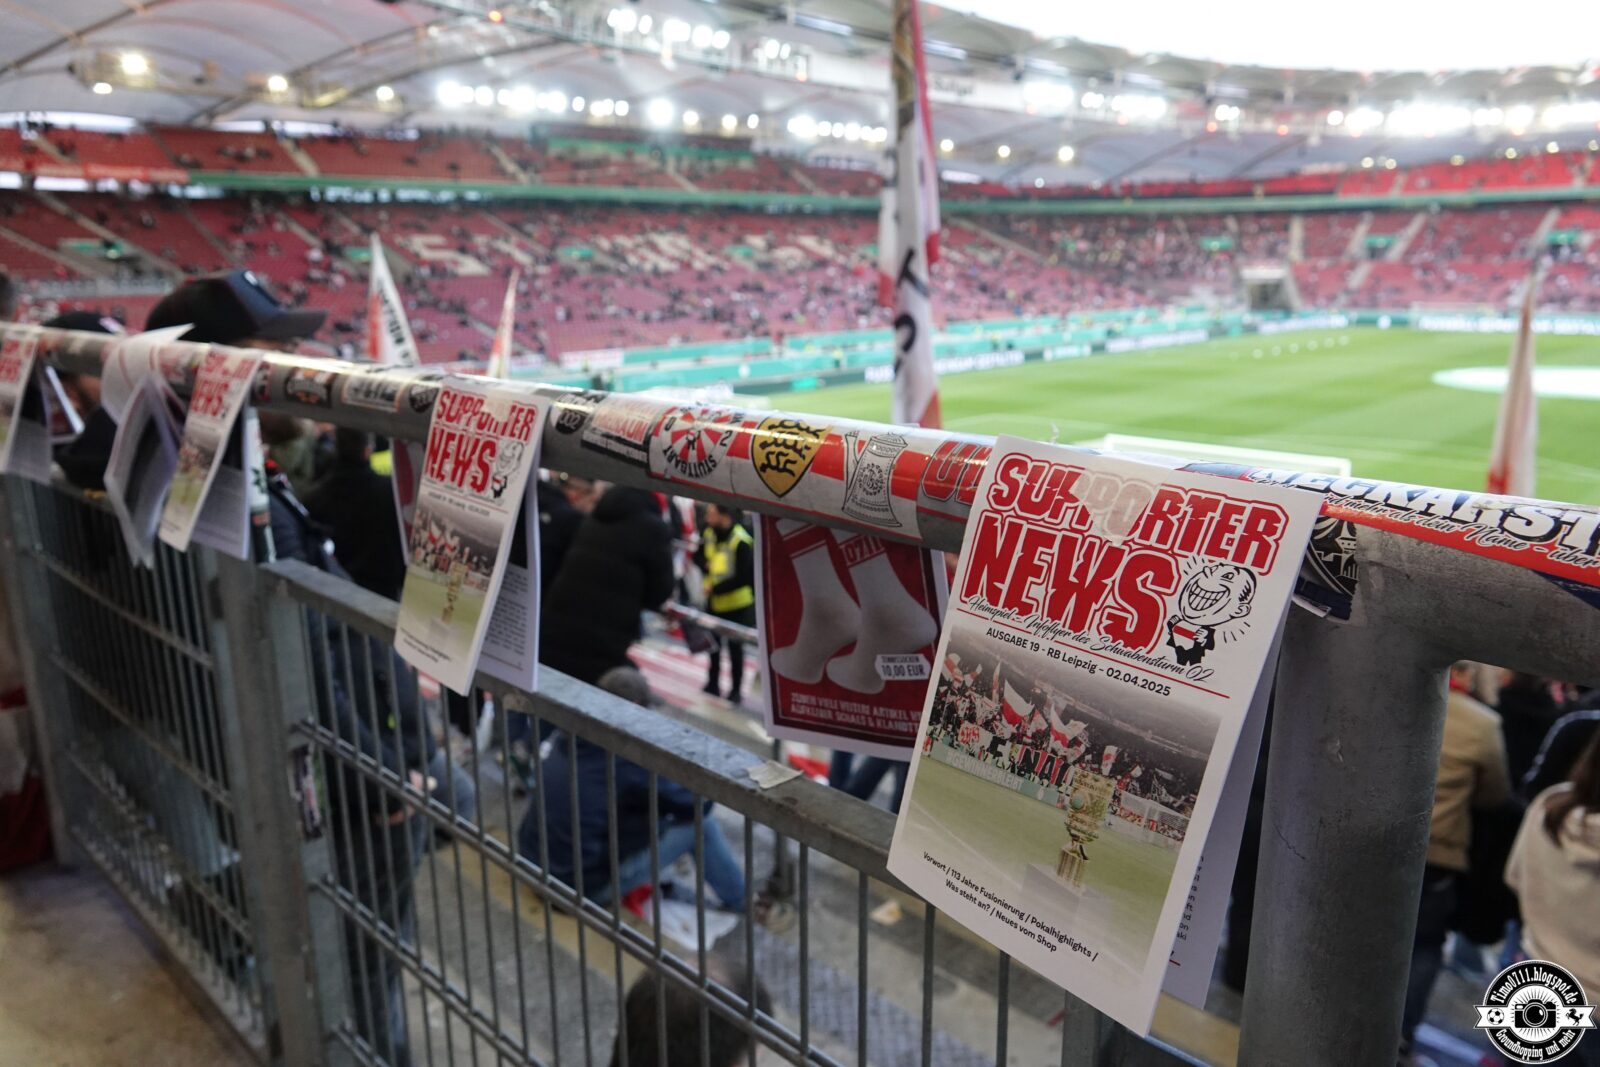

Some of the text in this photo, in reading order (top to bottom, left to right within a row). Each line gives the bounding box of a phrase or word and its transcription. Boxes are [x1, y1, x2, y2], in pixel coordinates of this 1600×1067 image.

[426, 427, 497, 492] NEWS
[663, 445, 717, 478] STUTTGART
[987, 452, 1289, 577] SUPPORTER
[1248, 469, 1600, 557] NECKARST
[1389, 506, 1416, 521] als
[1416, 514, 1456, 531] dein
[1462, 522, 1529, 549] Name
[1549, 548, 1600, 566] über
[960, 510, 1182, 655] NEWS
[908, 665, 926, 676] EUR
[969, 596, 1016, 620] Heimspiel
[1024, 614, 1071, 640] Infoflyer
[1072, 630, 1091, 644] des
[1090, 636, 1185, 675] Schwabensturm
[1186, 665, 1214, 683] 02
[986, 627, 1028, 649] AUSGABE
[1030, 641, 1040, 652] 19
[1047, 647, 1061, 660] RB
[1062, 652, 1098, 674] Leipzig
[1106, 667, 1171, 697] 02.04.2025
[924, 851, 946, 872] Vorwort
[951, 869, 961, 881] 113
[961, 875, 979, 892] Jahre
[979, 887, 1025, 921] Fusionierung
[1030, 916, 1092, 958] Pokalhighlights
[945, 878, 959, 894] Was
[959, 890, 977, 905] steht
[977, 901, 991, 912] an?
[995, 910, 1018, 929] Neues
[1019, 925, 1035, 940] vom
[1036, 934, 1057, 952] Shop
